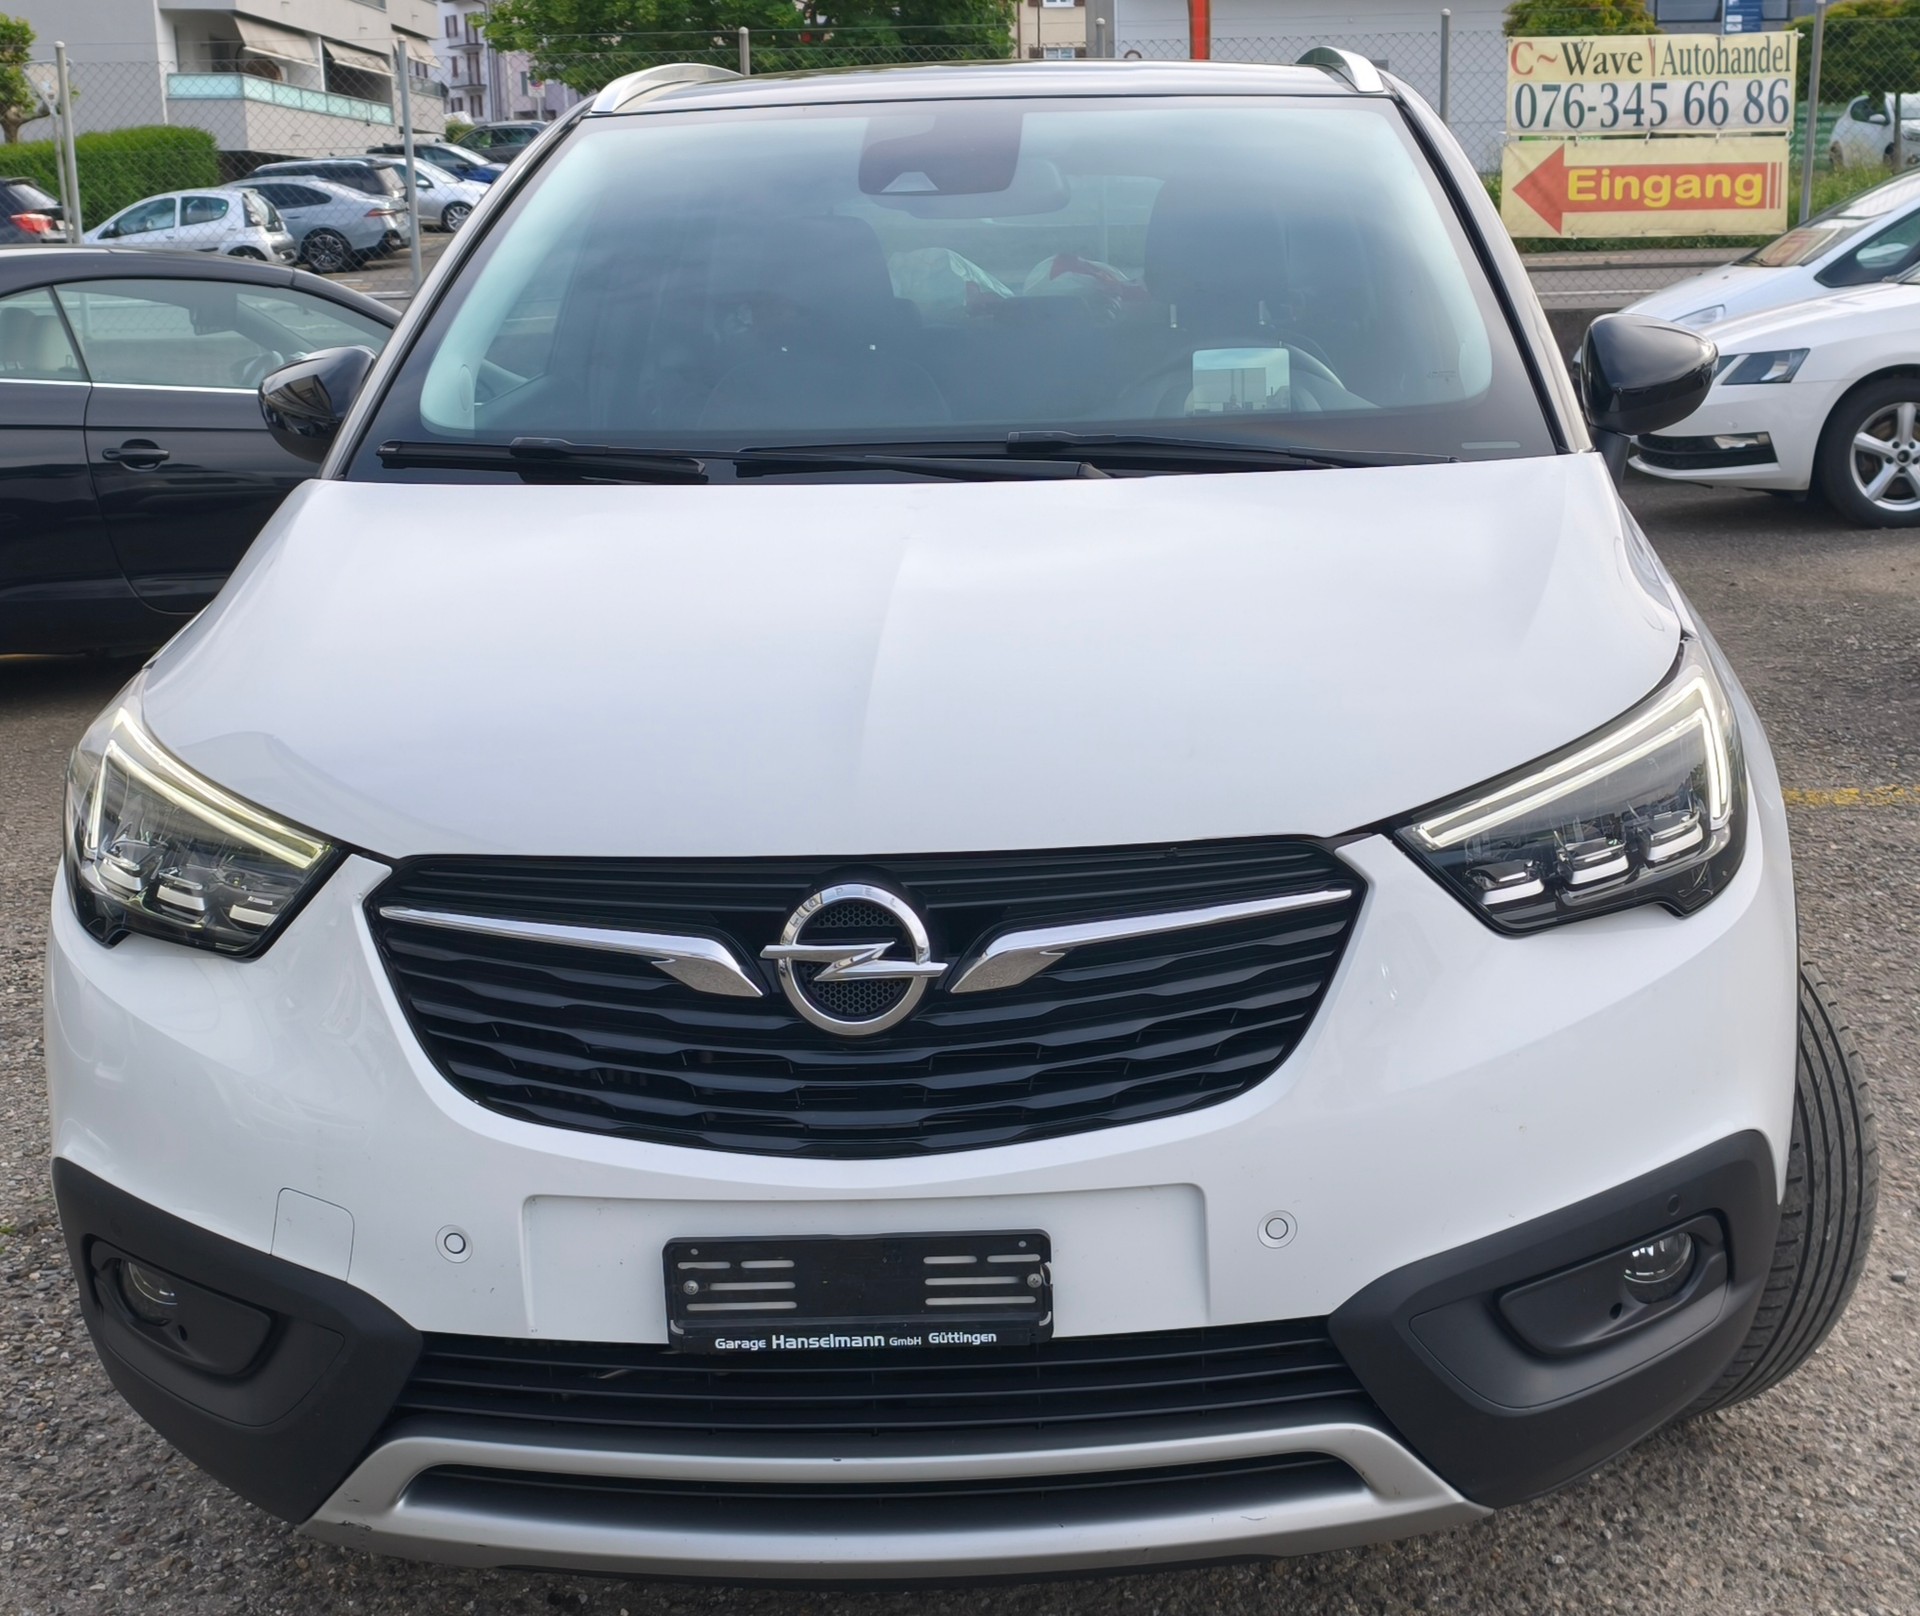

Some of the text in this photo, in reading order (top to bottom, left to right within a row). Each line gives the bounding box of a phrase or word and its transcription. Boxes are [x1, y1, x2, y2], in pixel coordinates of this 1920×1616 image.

[1660, 35, 1791, 76] Autohandel
[1515, 78, 1789, 128] 076-345 66 86
[1567, 168, 1763, 208] Eingang
[715, 1331, 997, 1351] Garage Hanselmann GmbH Güttingen
